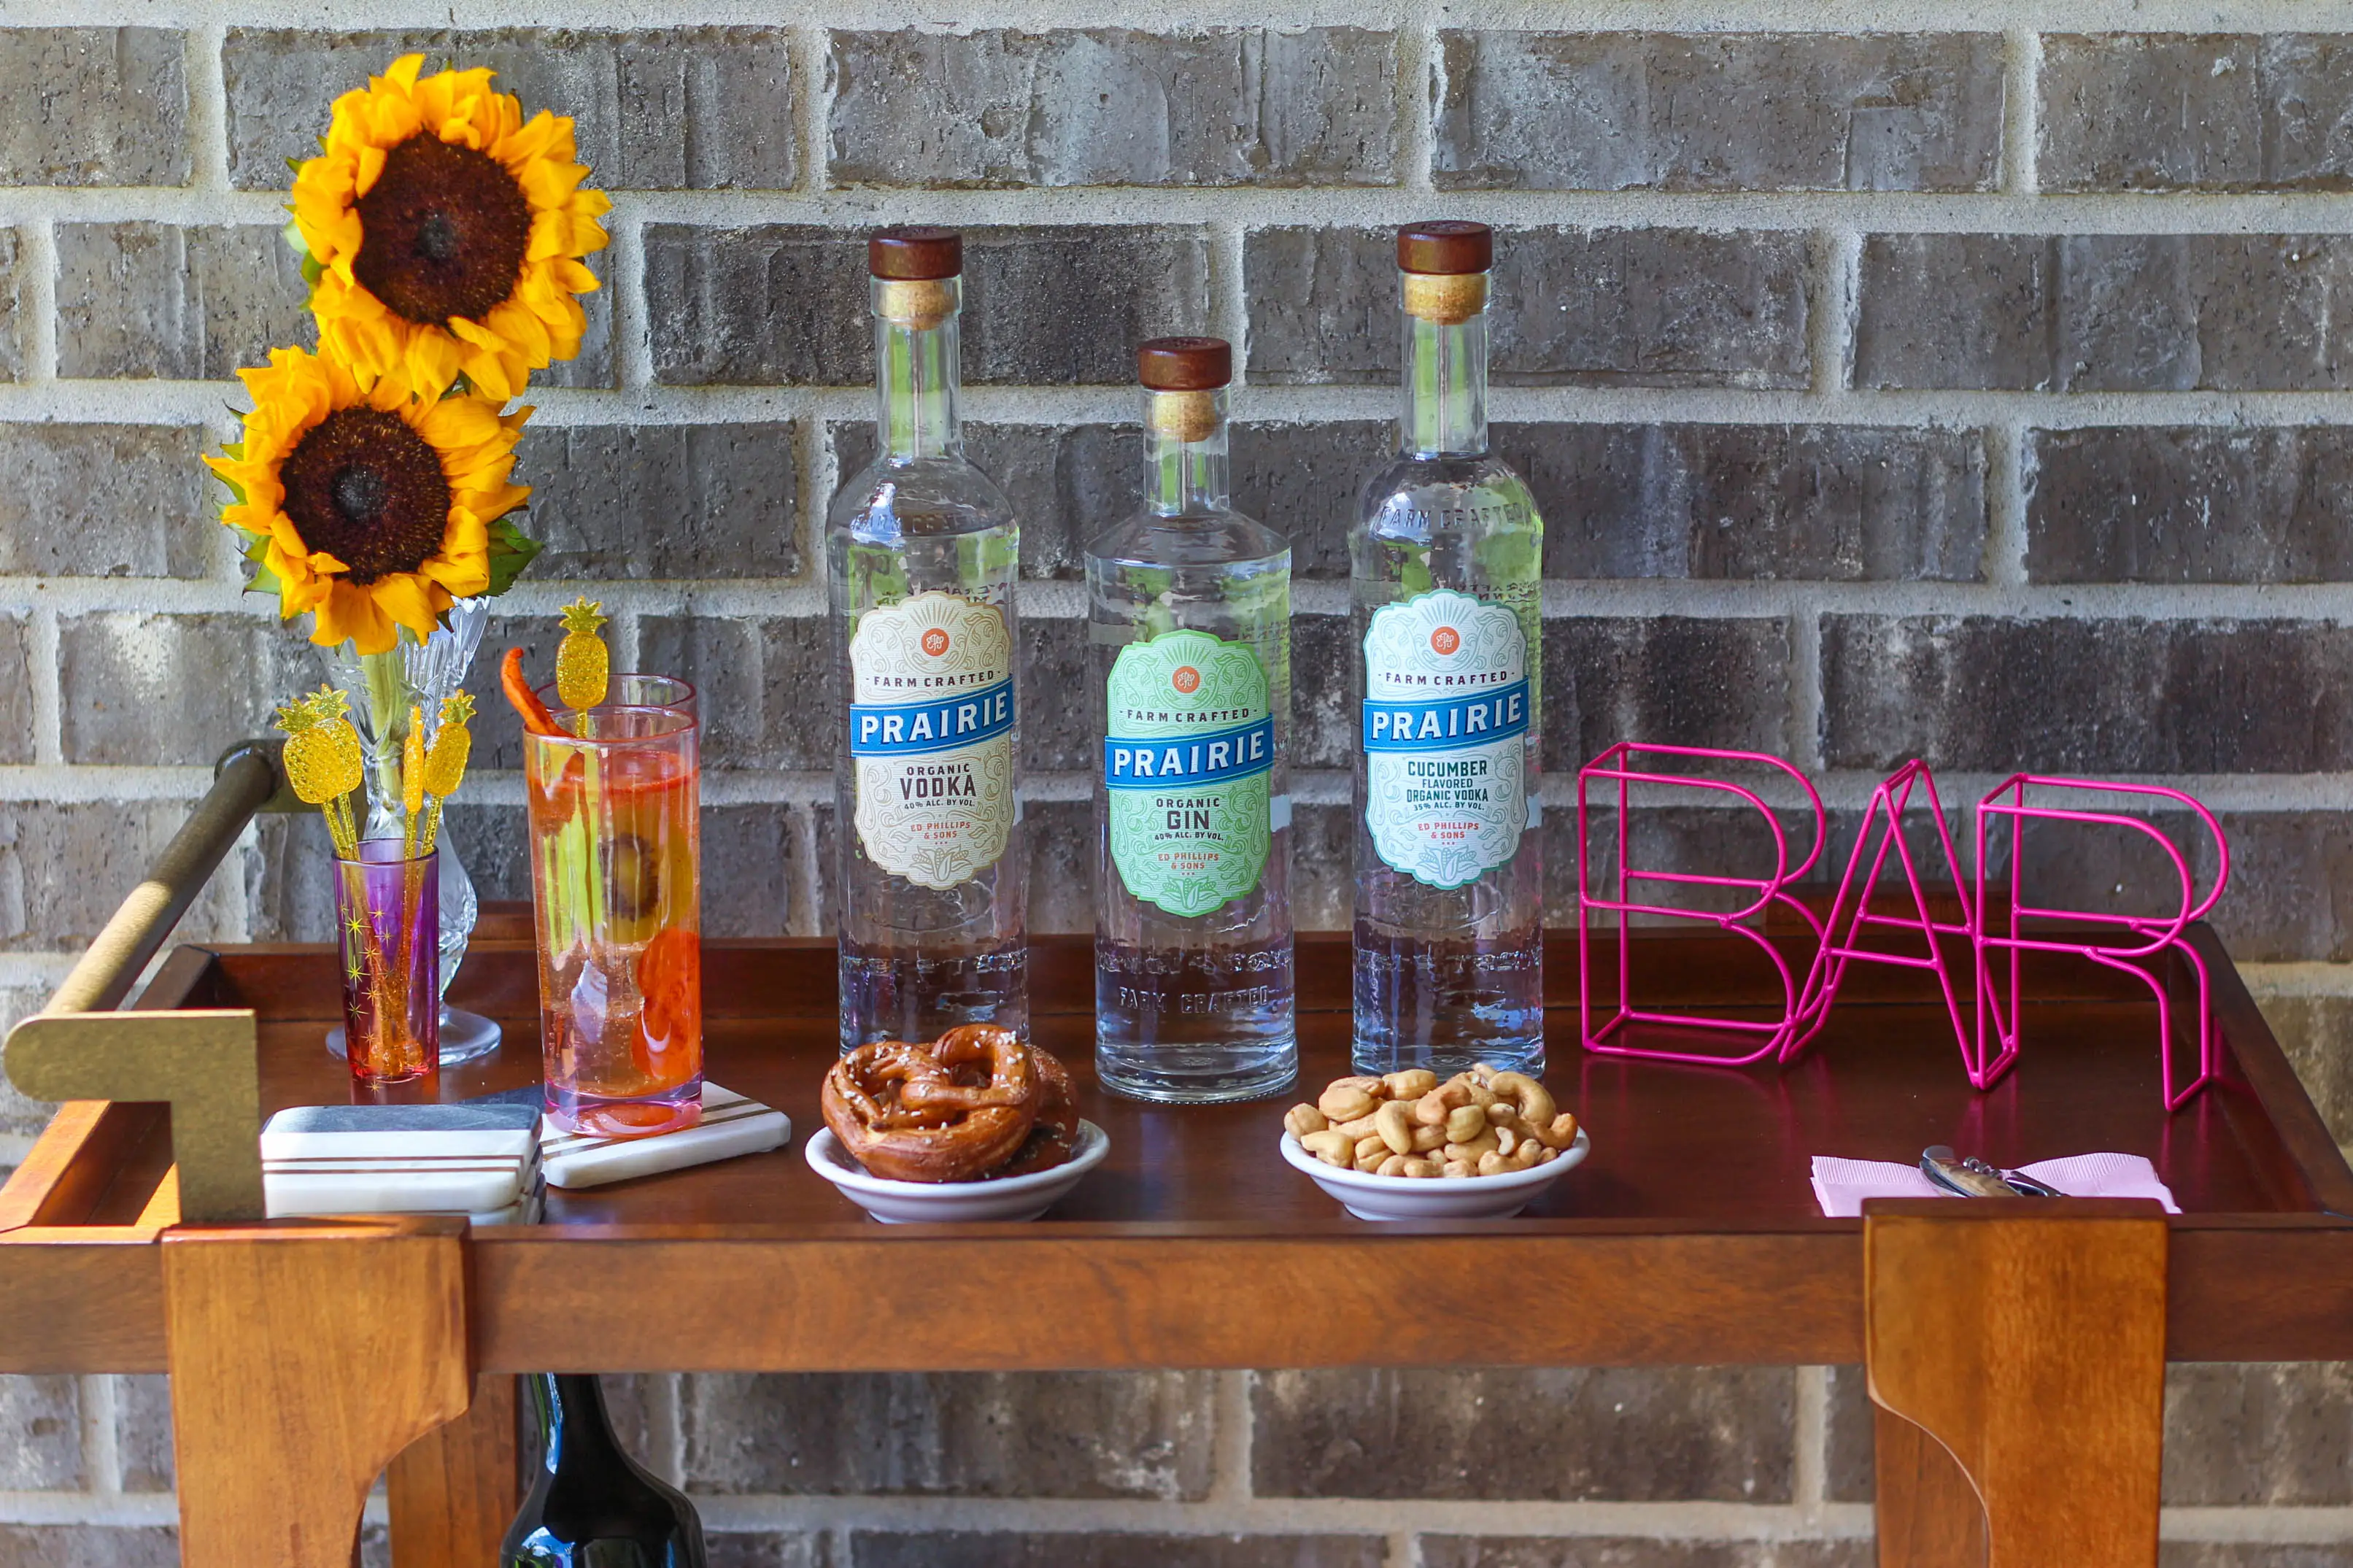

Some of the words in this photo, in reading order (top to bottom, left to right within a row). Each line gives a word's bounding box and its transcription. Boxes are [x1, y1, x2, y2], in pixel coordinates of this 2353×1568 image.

[874, 676, 917, 688] FARM
[924, 671, 994, 687] CRAFTED
[1386, 672, 1426, 685] FARM
[1434, 671, 1507, 685] CRAFTED
[860, 691, 1008, 744] PRAIRIE
[1127, 710, 1168, 722] FARM
[1175, 708, 1250, 722] CRAFTED
[1372, 692, 1522, 741] PRAIRIE
[1113, 730, 1264, 776] PRAIRIE
[906, 763, 970, 776] ORGANIC
[1408, 760, 1488, 777] CUCUMBER
[900, 774, 977, 800] VODKA
[1422, 778, 1473, 789] FLAVORED
[1407, 789, 1451, 803] ORGANIC
[1454, 788, 1489, 802] VODKA
[904, 802, 923, 810] 40%
[959, 799, 975, 807] VOL.
[1156, 797, 1220, 808] ORGANIC
[1413, 802, 1431, 811] 35%
[1468, 802, 1485, 811] VOL.
[1167, 810, 1210, 830] GIN
[1418, 823, 1430, 831] ED
[1434, 822, 1480, 830] PHILLIPS
[911, 824, 922, 832] ED
[927, 822, 971, 830] PHILLIPS
[924, 832, 930, 840] &
[933, 830, 957, 838] SONS
[1154, 833, 1172, 841] 40%
[1208, 833, 1224, 841] VOL.
[1431, 831, 1437, 839] &
[1440, 831, 1465, 839] SONS
[1158, 854, 1170, 862] ED
[1174, 852, 1220, 861] PHILLIPS
[1180, 862, 1205, 870] SONS
[1579, 742, 2229, 1113] BAR
